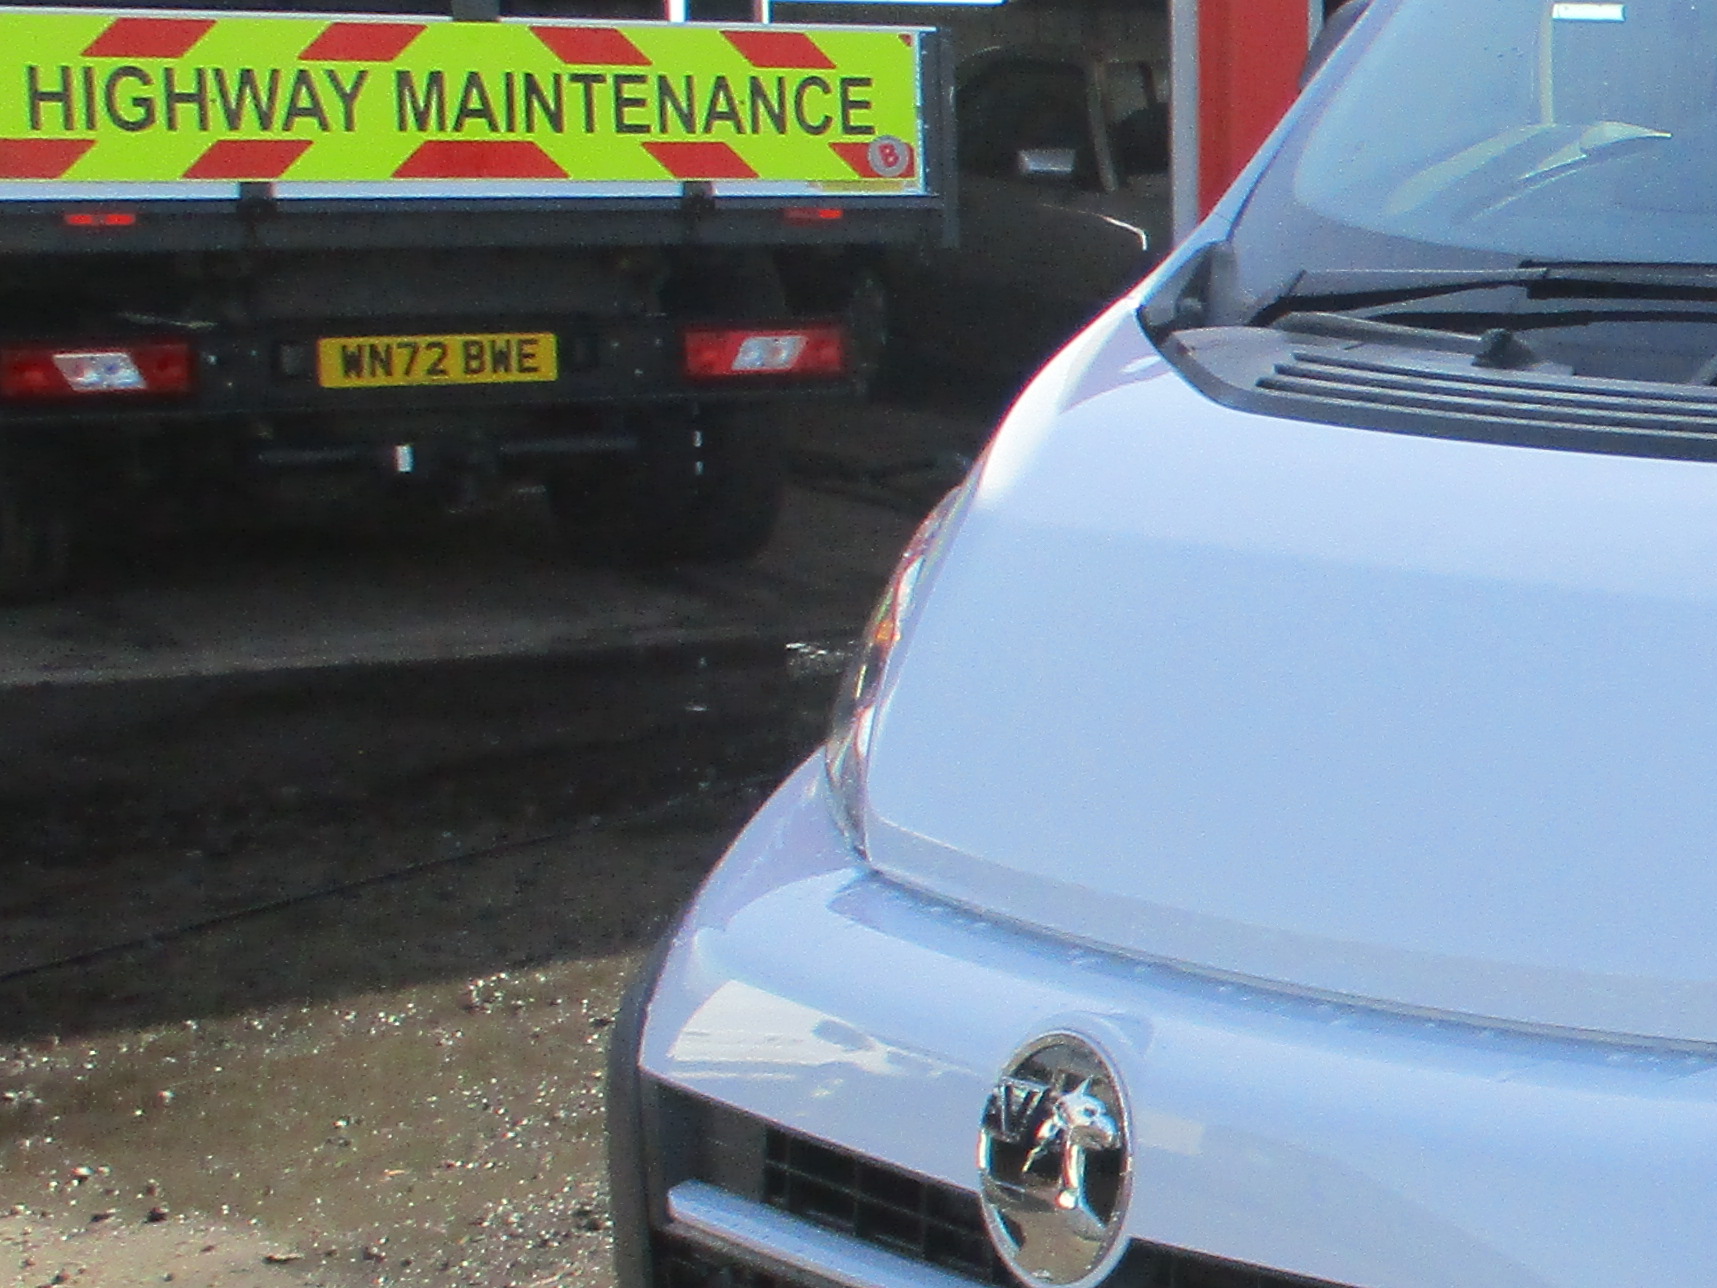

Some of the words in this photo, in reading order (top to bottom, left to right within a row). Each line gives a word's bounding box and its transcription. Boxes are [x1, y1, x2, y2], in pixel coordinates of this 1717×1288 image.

[26, 65, 369, 131] HIGHWAY
[396, 70, 876, 136] MAINTENANCE
[342, 341, 447, 378] WN72
[463, 339, 539, 374] BWE
